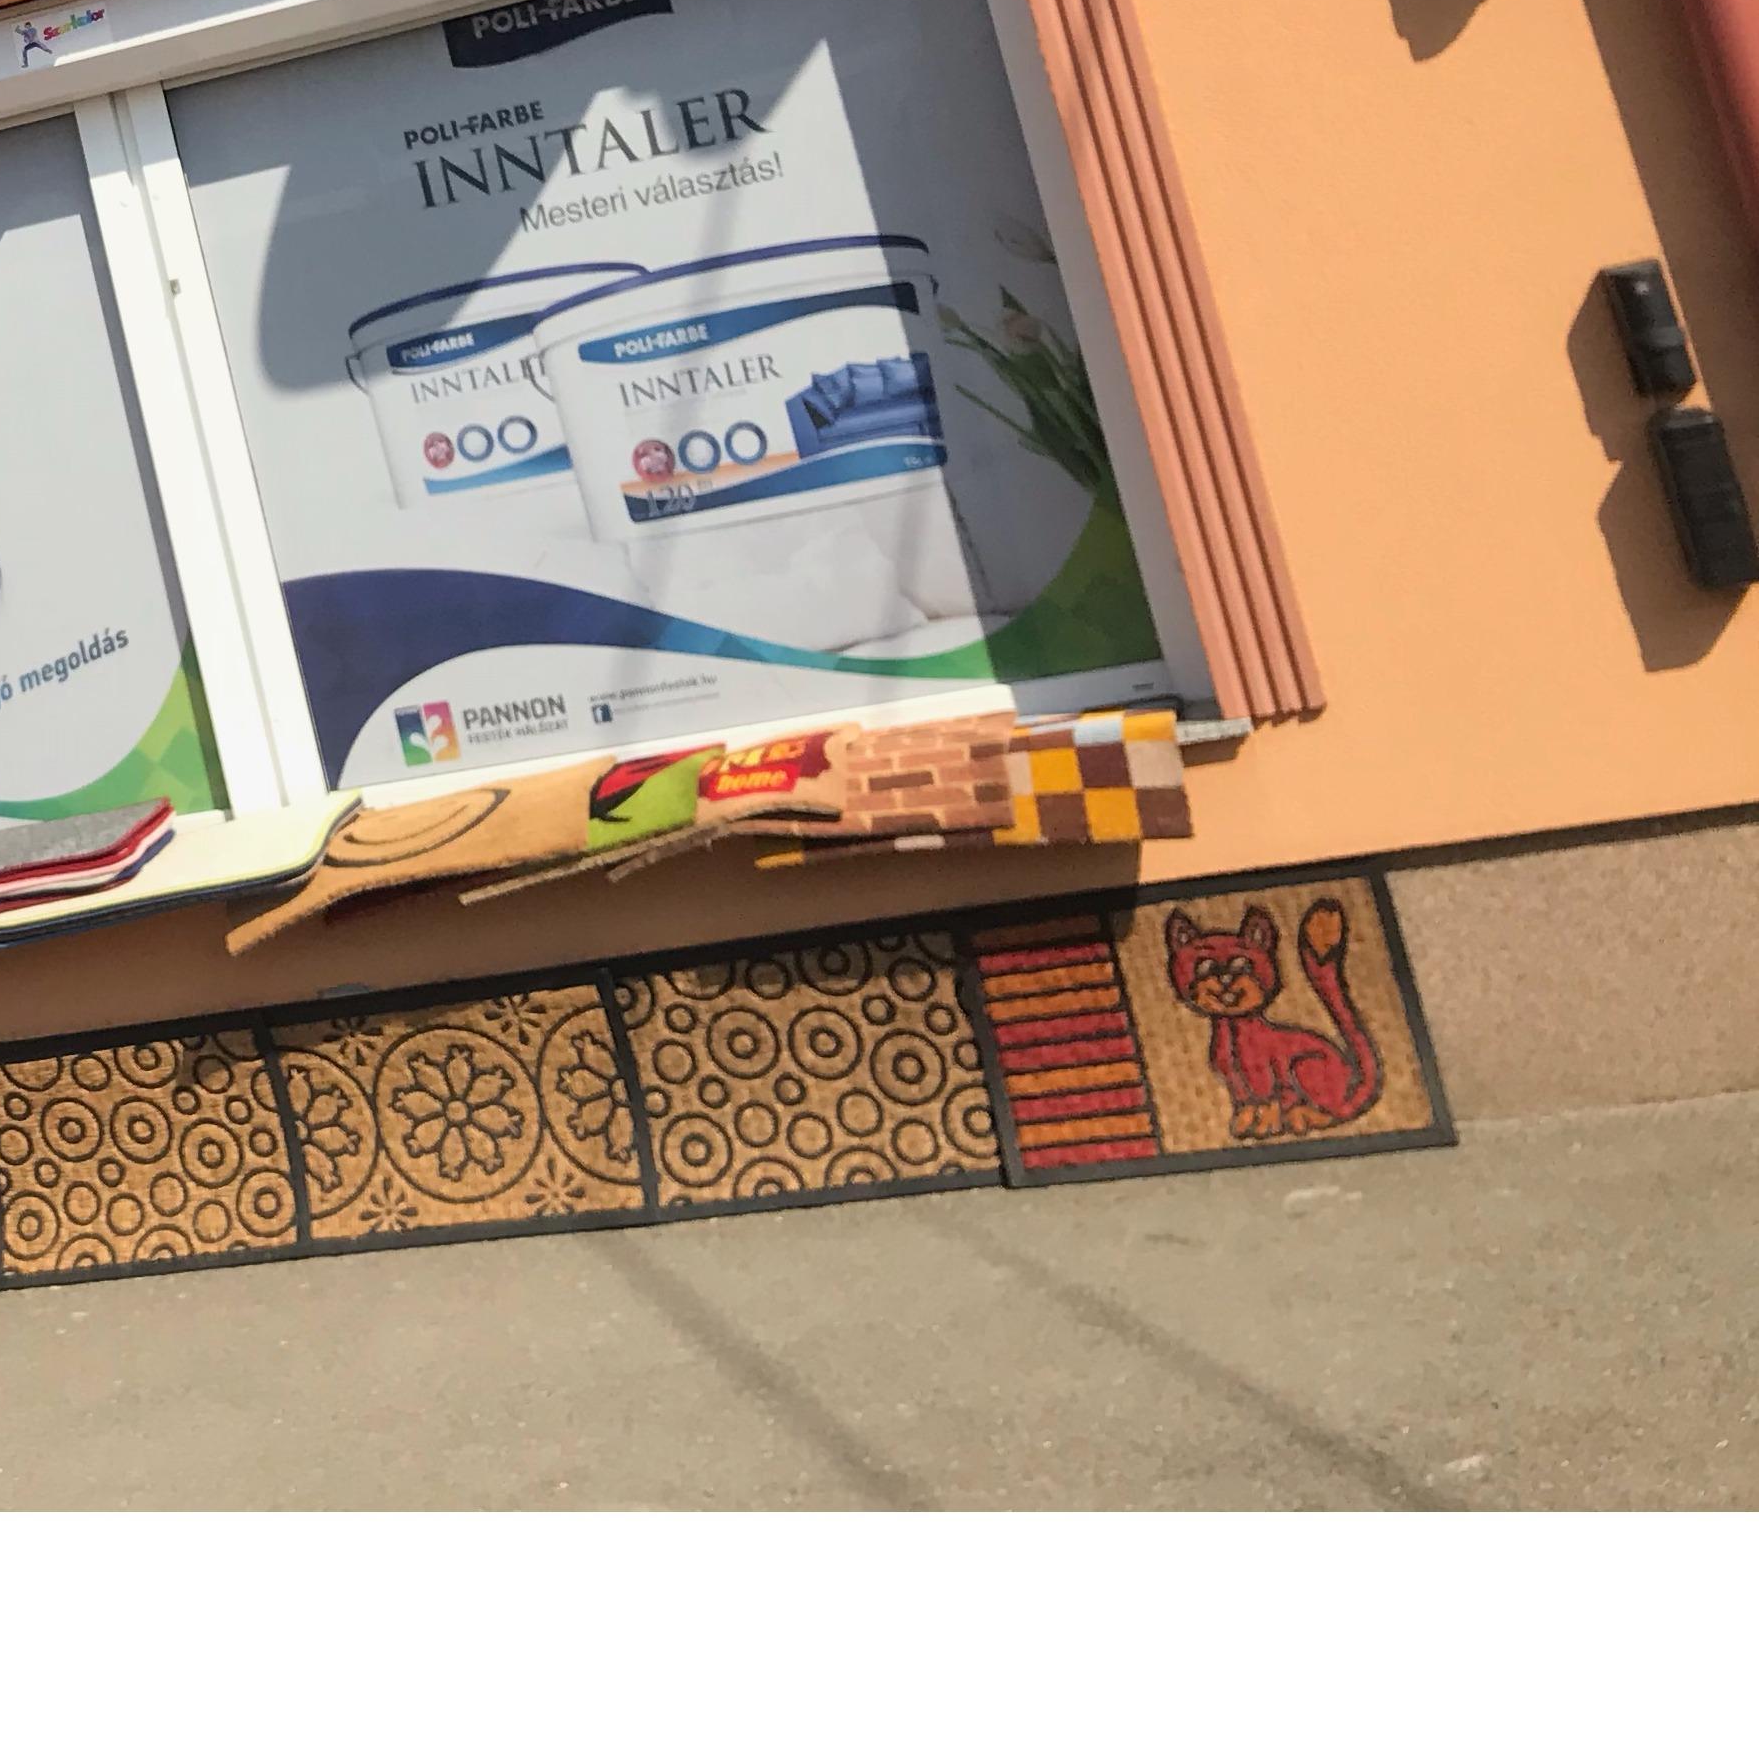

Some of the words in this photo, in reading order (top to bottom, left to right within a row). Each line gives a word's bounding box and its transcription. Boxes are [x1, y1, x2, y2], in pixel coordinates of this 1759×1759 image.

[403, 100, 545, 149] POLI-FARBE
[414, 89, 772, 209] INNTALER
[520, 193, 629, 233] Mesteri
[634, 151, 784, 208] választás!
[614, 323, 709, 358] POLI-FARBE
[619, 353, 782, 407] INNTALER
[19, 627, 129, 692] megoldás
[463, 694, 567, 730] PANNON
